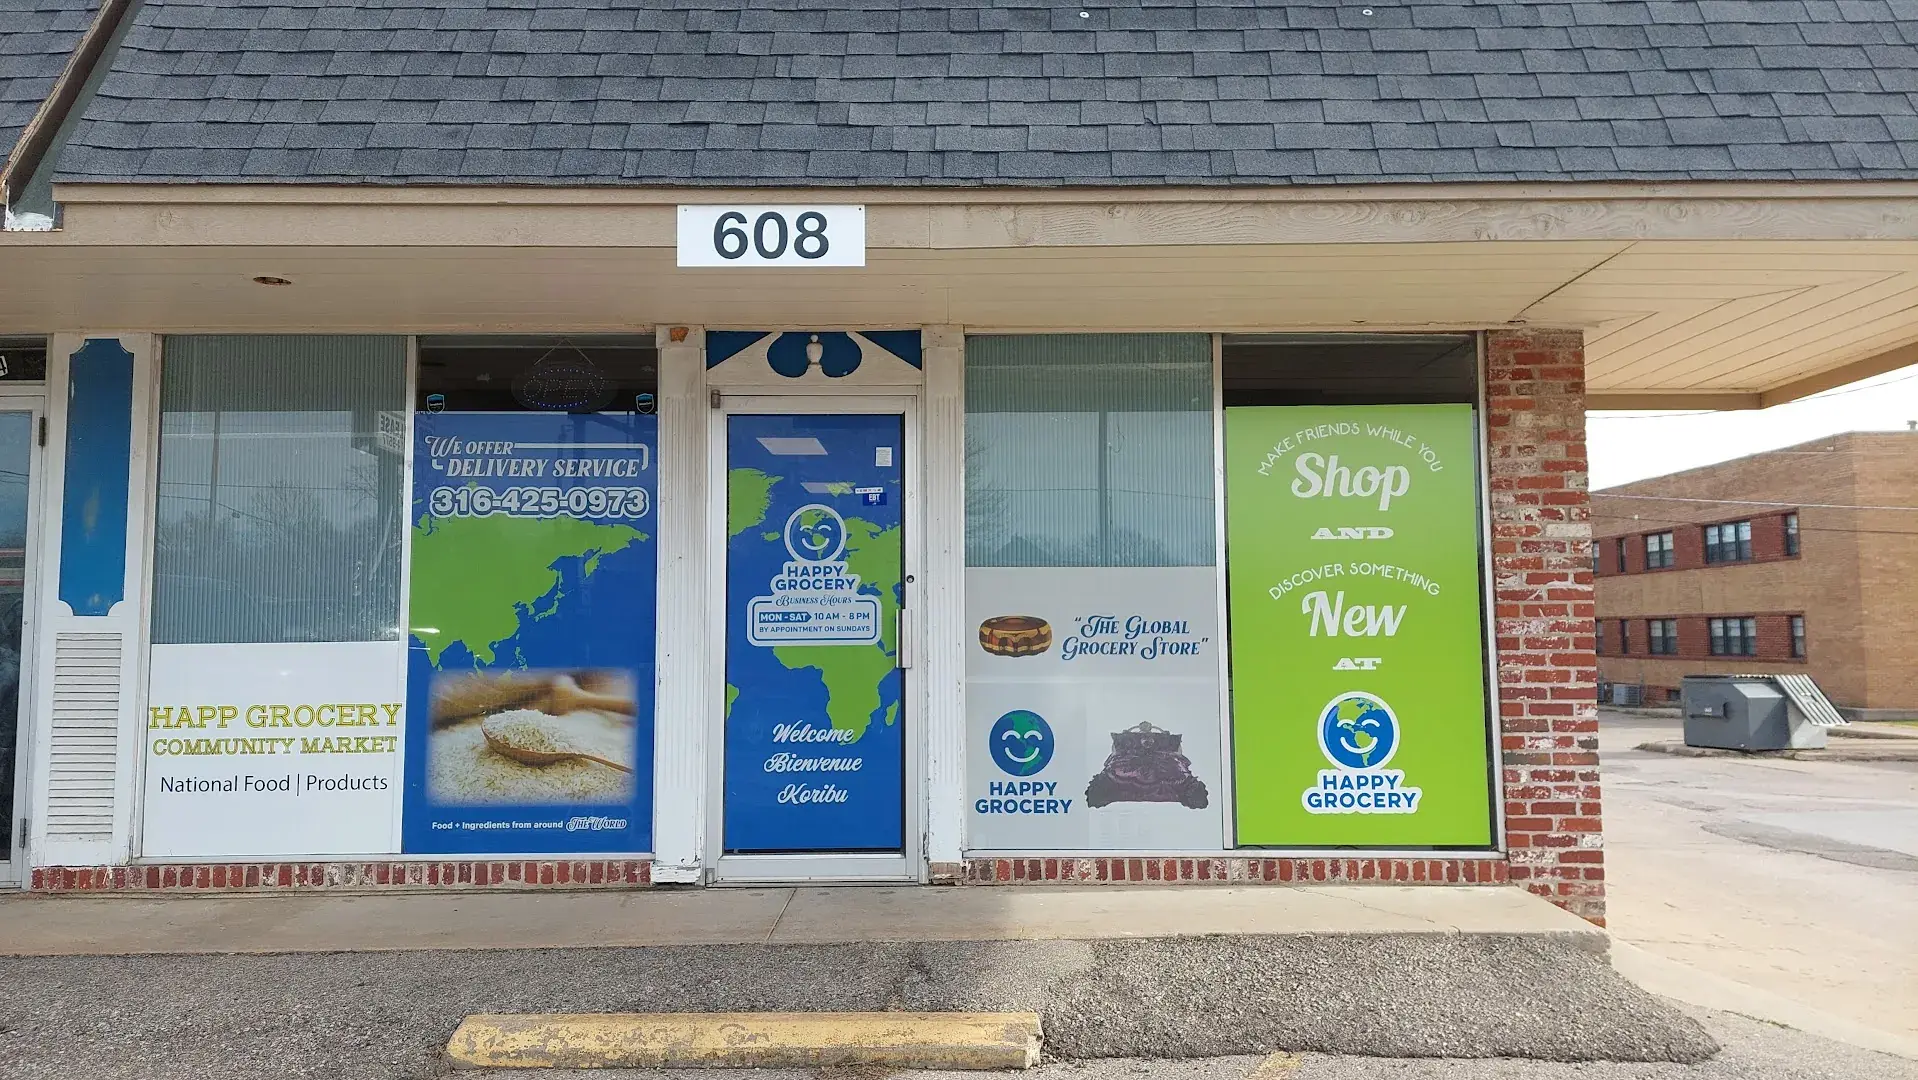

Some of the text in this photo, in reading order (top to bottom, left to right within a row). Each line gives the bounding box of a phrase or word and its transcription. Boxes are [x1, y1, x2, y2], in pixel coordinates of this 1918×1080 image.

[714, 211, 829, 260] 608
[523, 379, 606, 398] OPEN
[424, 436, 461, 458] WE
[466, 441, 514, 455] OFFER
[1258, 423, 1443, 476] MAKE FRIENDS WHILE YOU
[446, 458, 640, 478] DELIVERY SERVICE
[1292, 452, 1410, 511] Shop
[430, 488, 648, 517] 316-425-0973
[1310, 527, 1394, 540] AND
[787, 565, 844, 577] HAPPY
[1268, 562, 1440, 600] DISCOVER SOMETHING
[775, 578, 856, 591] GROCERY
[776, 594, 852, 606] BUSINESS HOURS
[814, 612, 824, 620] 10
[826, 612, 840, 620] AM
[856, 612, 870, 620] PM
[1302, 590, 1408, 636] New
[1124, 615, 1190, 640] GLOBAL
[1062, 636, 1138, 660] GROCERY
[1332, 657, 1382, 670] AT
[149, 703, 402, 729] HAPP GROCERY
[772, 720, 854, 743] Welcome
[152, 736, 398, 756] COMMUNITY MARKET
[764, 752, 863, 772] Bienvenue
[160, 776, 238, 792] National
[244, 775, 290, 792] Food
[306, 774, 388, 791] Products
[990, 782, 1058, 796] HAPPY
[1323, 774, 1399, 790] HAPPY
[777, 783, 848, 804] Koribu
[1308, 792, 1417, 808] GROCERY
[975, 798, 1072, 814] GROCERY
[432, 821, 452, 830] Food
[462, 821, 510, 831] Ingredients
[512, 820, 532, 828] from
[534, 820, 563, 828] around
[566, 816, 589, 831] THE
[588, 816, 627, 830] WORLD
